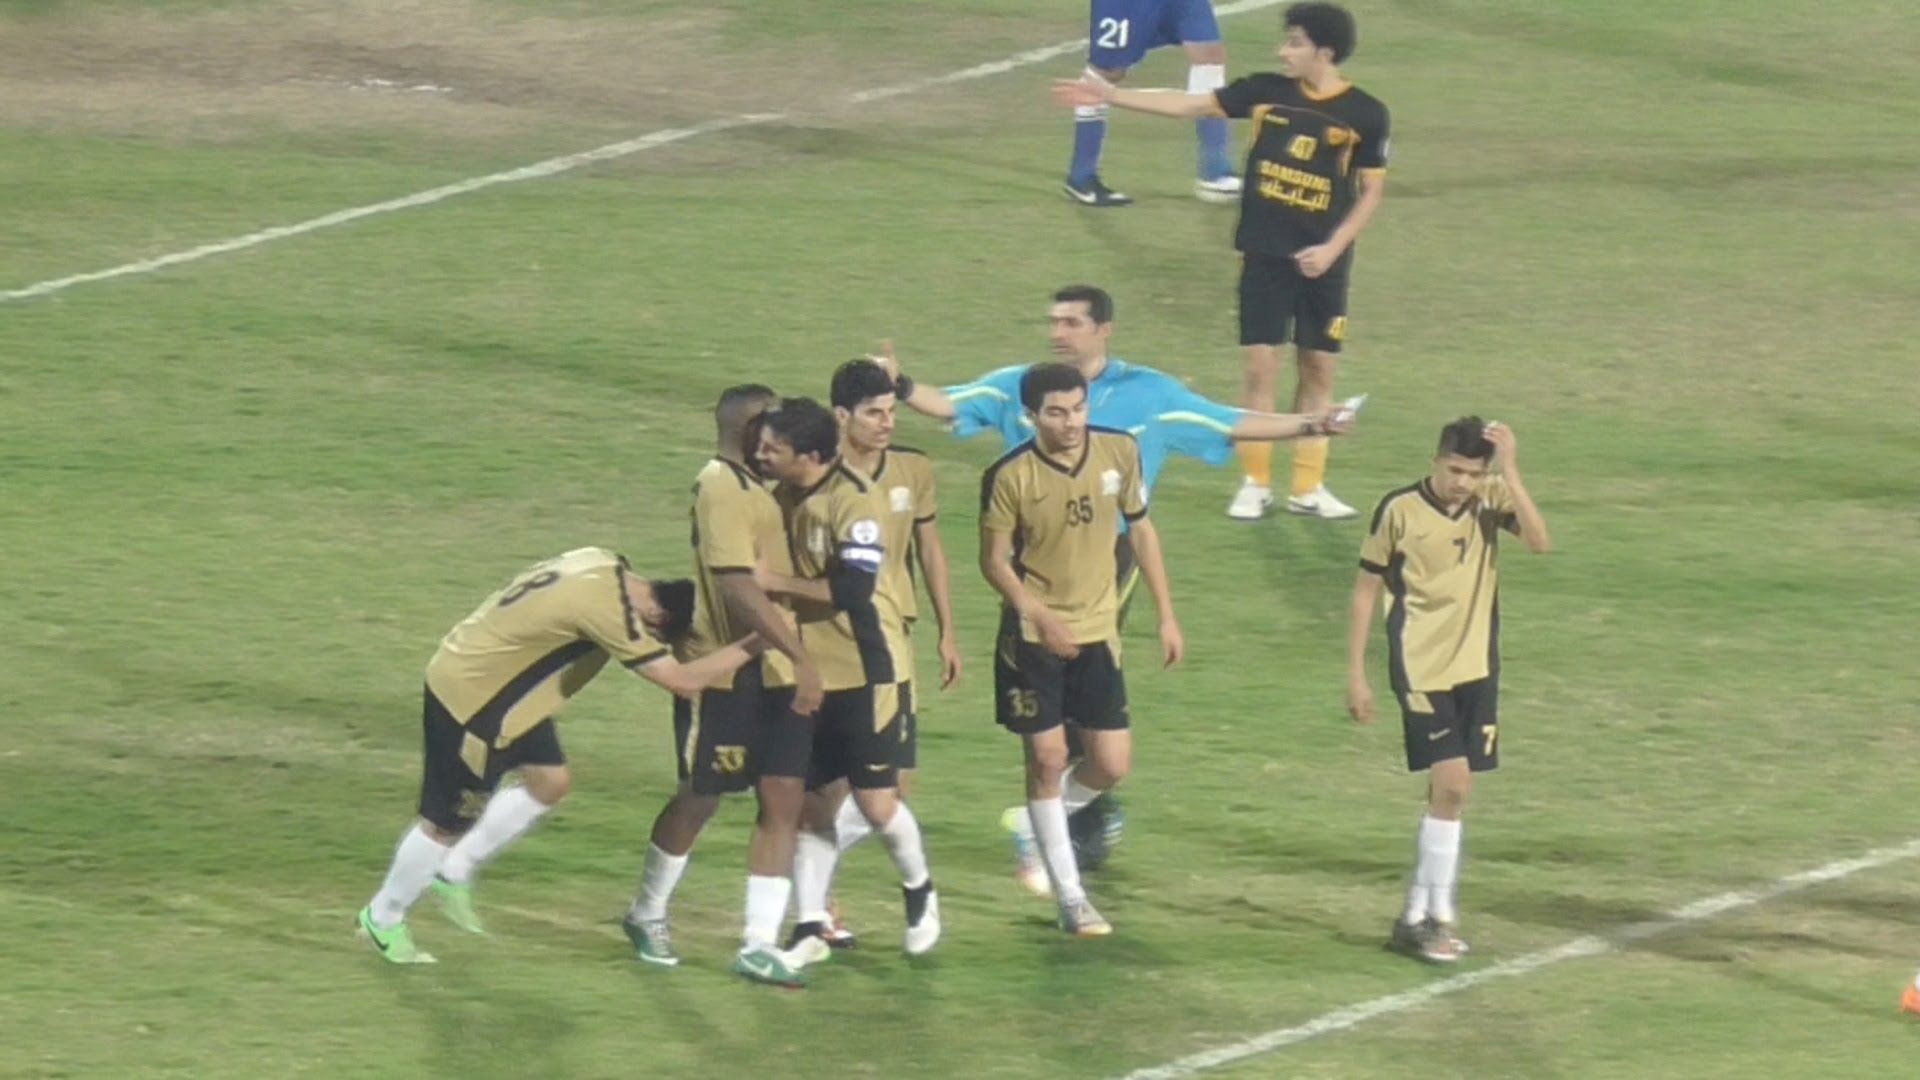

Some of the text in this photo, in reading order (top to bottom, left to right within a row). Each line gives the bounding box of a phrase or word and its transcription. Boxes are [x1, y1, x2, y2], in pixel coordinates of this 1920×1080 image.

[1097, 17, 1129, 48] 21
[1066, 495, 1093, 527] 35
[1453, 537, 1467, 565] 7
[1007, 686, 1039, 718] 35
[1481, 724, 1497, 757] 7
